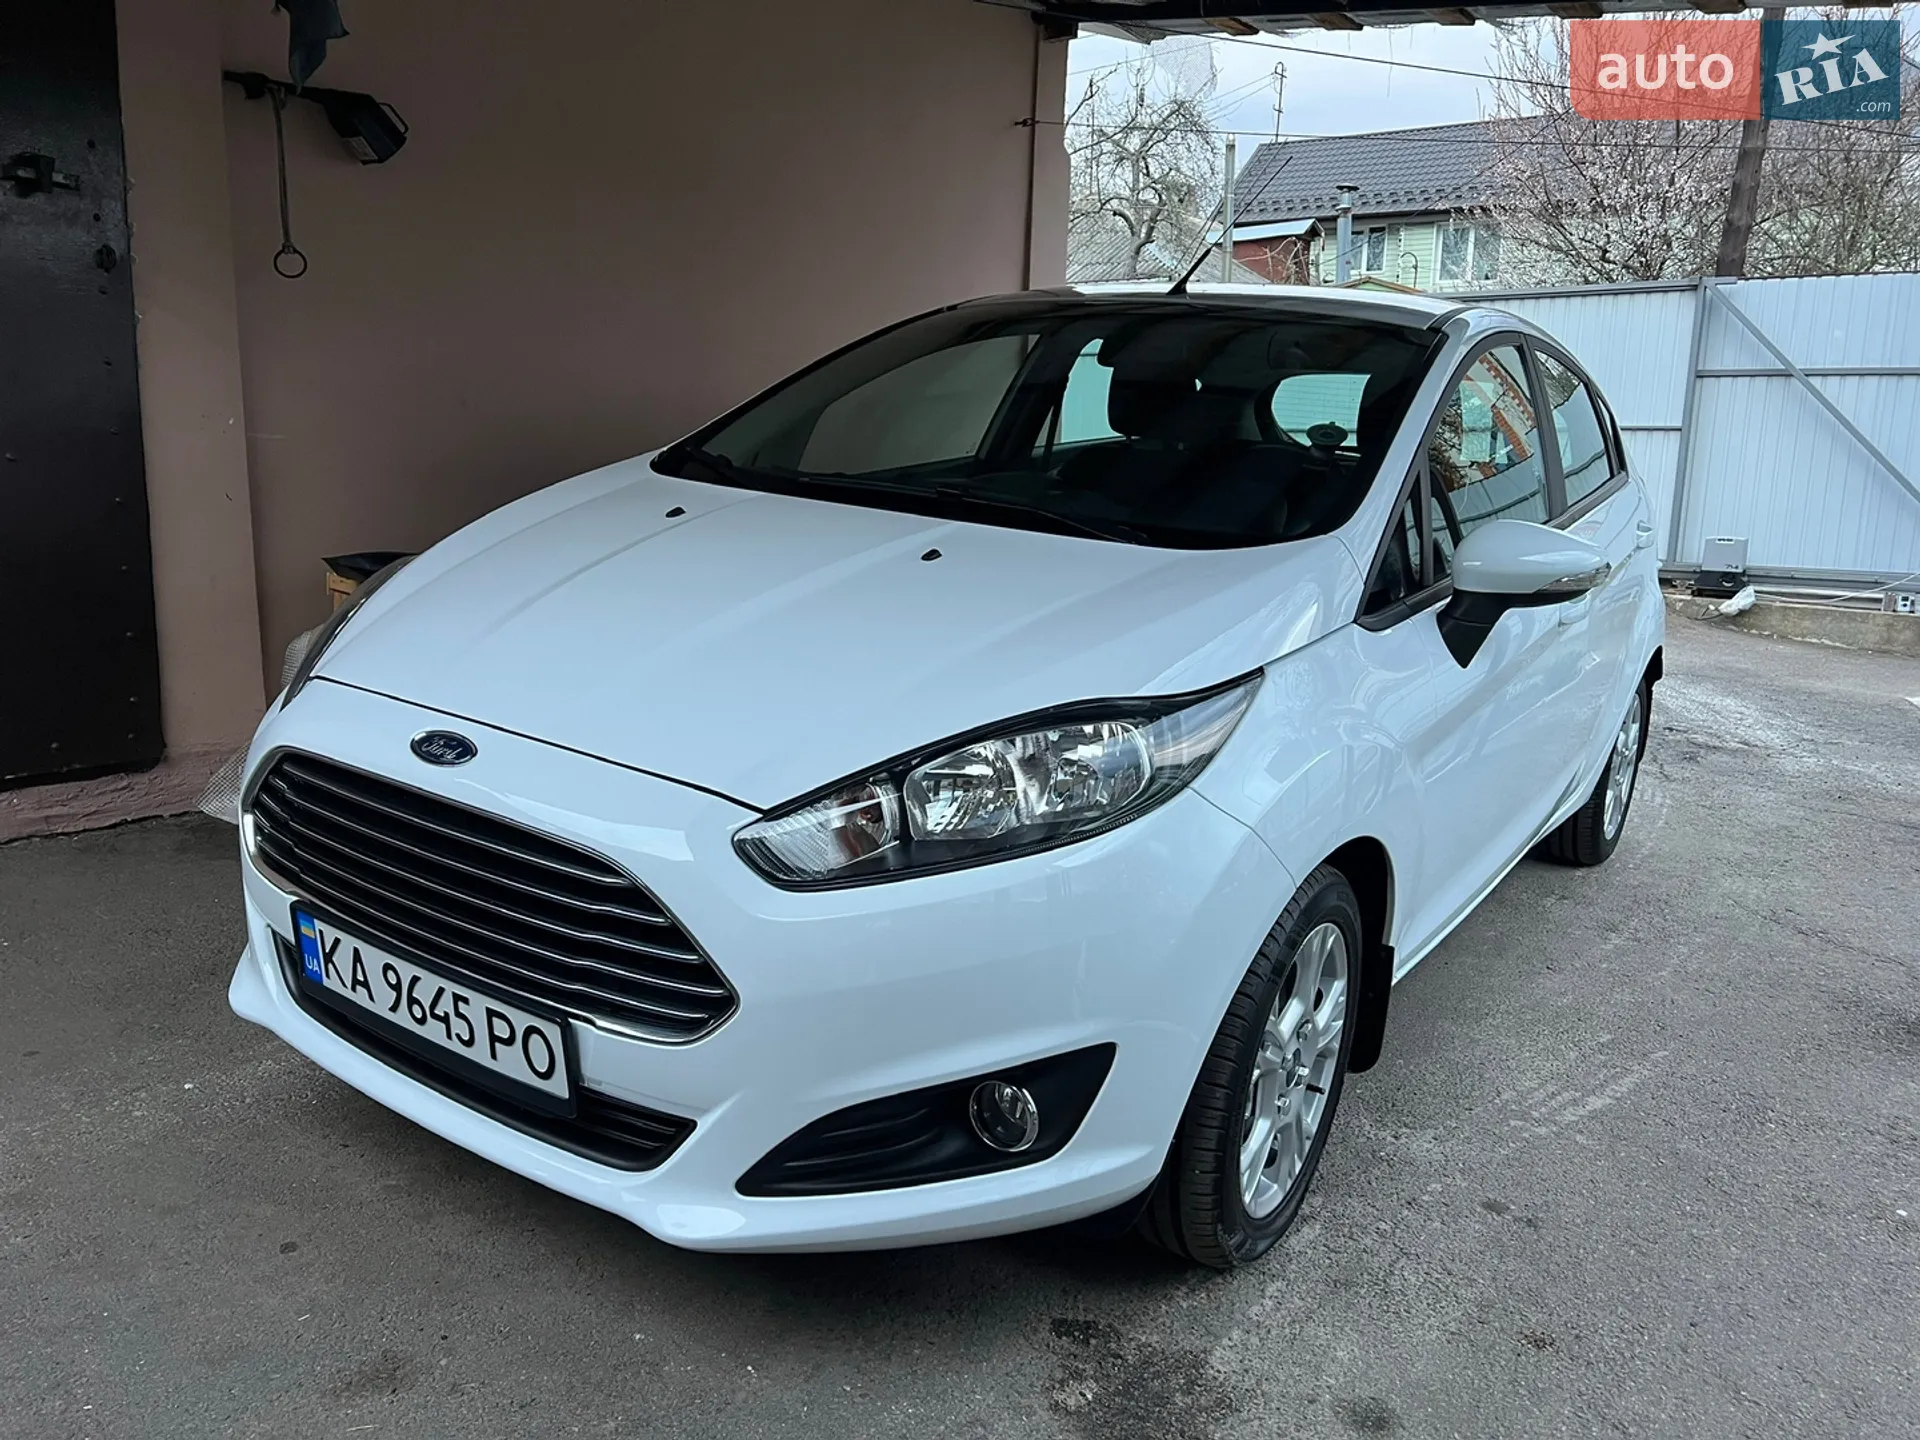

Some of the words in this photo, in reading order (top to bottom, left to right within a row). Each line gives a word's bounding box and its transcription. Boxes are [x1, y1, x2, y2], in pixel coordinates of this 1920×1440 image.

[421, 736, 462, 760] Ford
[304, 953, 320, 974] UA
[318, 928, 376, 1004] KA
[381, 961, 476, 1048] 9645
[485, 1006, 556, 1081] PO
